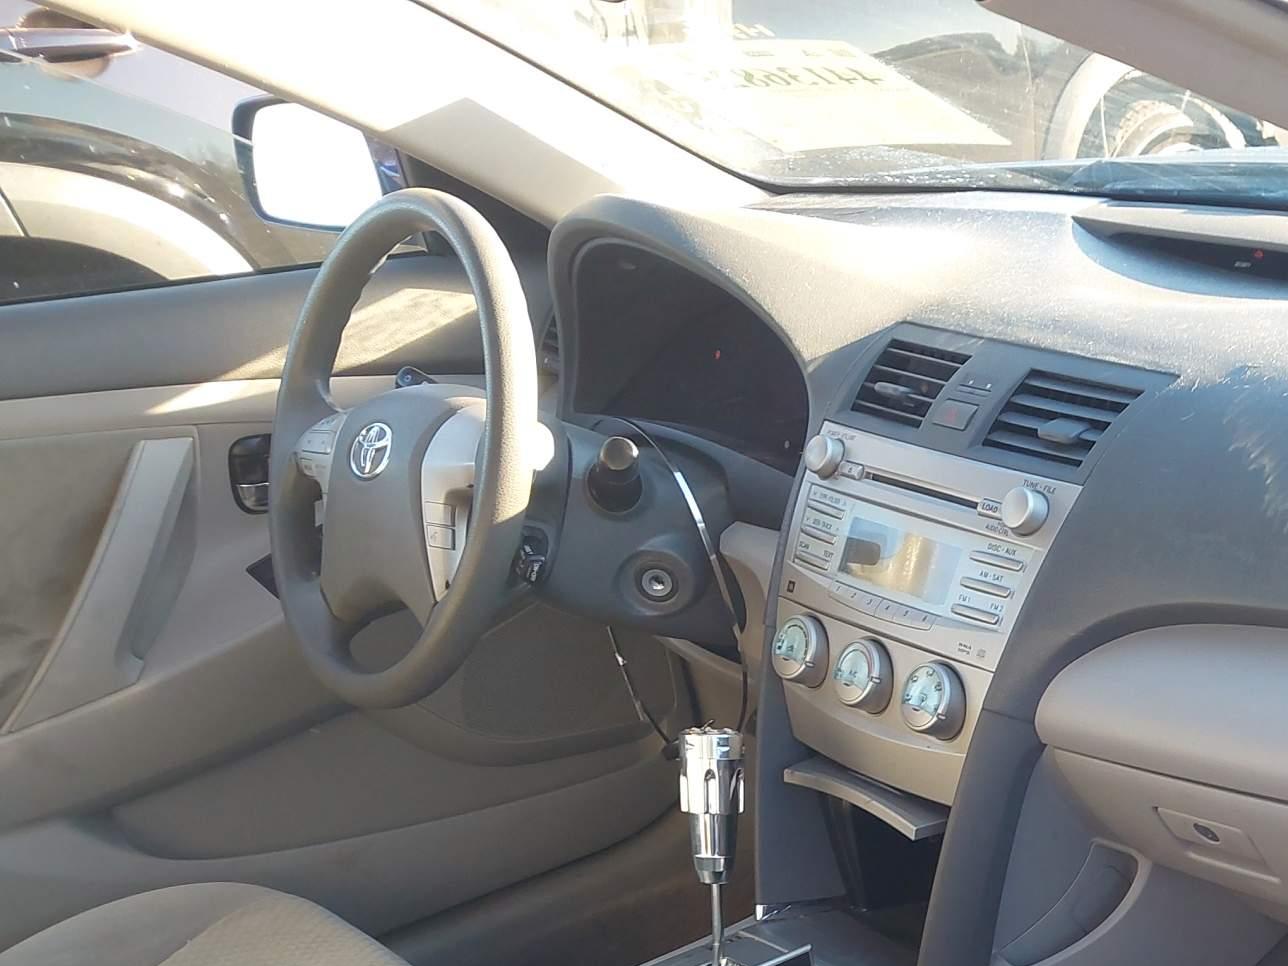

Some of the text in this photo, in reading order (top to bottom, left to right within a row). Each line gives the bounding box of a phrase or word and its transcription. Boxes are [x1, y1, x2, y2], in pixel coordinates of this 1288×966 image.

[1023, 480, 1056, 494] TUNE FILE
[981, 503, 998, 513] LOAD
[1005, 547, 1017, 556] AUX
